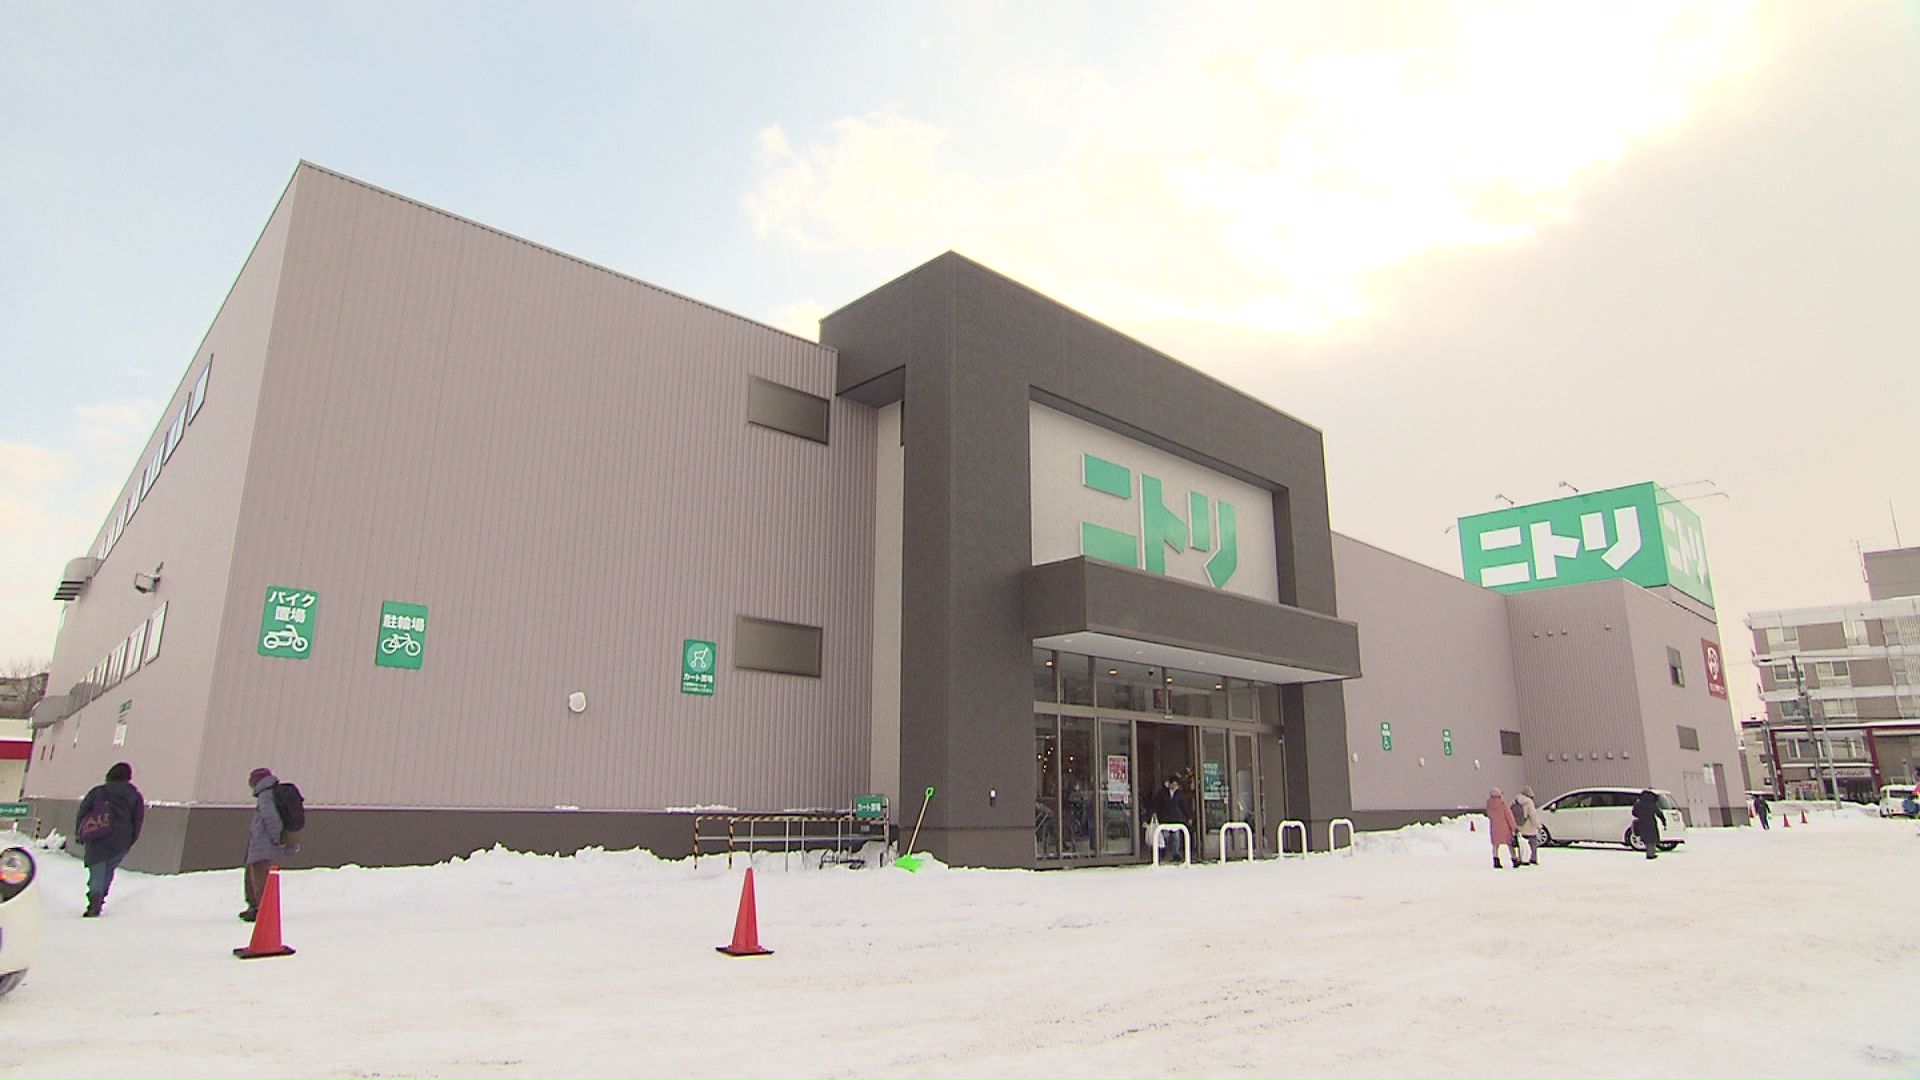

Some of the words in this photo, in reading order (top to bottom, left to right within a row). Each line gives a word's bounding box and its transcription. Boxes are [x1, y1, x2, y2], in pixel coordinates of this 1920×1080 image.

[1080, 453, 1238, 589] ニトリ
[1479, 505, 1642, 588] ニトリ
[1662, 506, 1706, 585] ニトリ
[268, 591, 316, 608] バイク
[275, 606, 306, 623] 置場
[383, 614, 425, 632] 駐輪場
